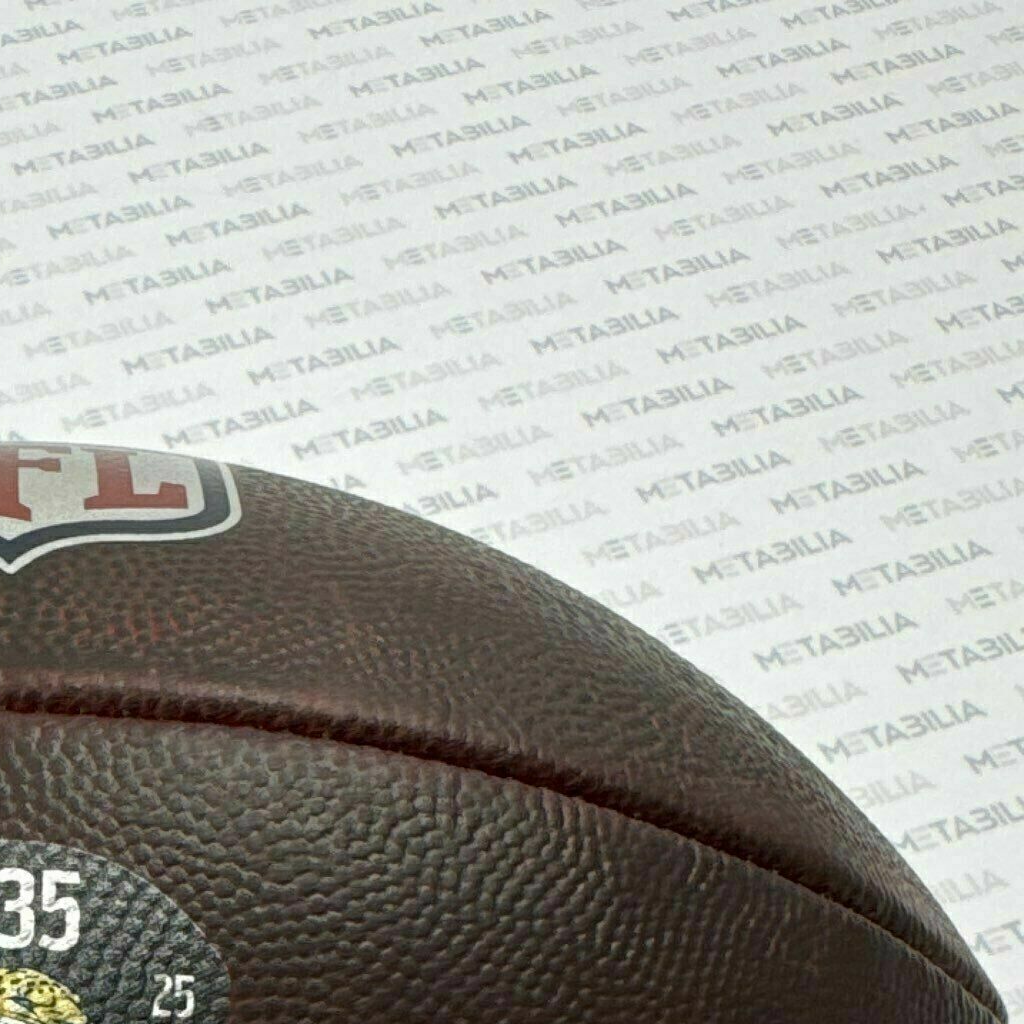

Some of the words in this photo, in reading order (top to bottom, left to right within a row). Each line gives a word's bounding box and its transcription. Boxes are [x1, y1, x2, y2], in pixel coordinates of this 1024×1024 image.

[307, 2, 444, 40] METABILIA
[419, 9, 554, 48] METABILIA
[57, 27, 193, 66] METABILIA
[716, 38, 851, 78] METABILIA
[830, 45, 965, 85] METABILIA
[348, 57, 486, 98] METABILIA
[461, 64, 600, 106] METABILIA
[91, 83, 233, 124] METABILIA
[766, 92, 904, 137] METABILIA
[884, 103, 1021, 145] METABILIA
[11, 133, 156, 176] METABILIA
[390, 116, 531, 158] METABILIA
[506, 122, 648, 165] METABILIA
[127, 142, 271, 185] METABILIA
[819, 155, 960, 199] METABILIA
[47, 195, 195, 240] METABILIA
[434, 175, 578, 220] METABILIA
[554, 183, 698, 228] METABILIA
[165, 202, 313, 247] METABILIA
[875, 218, 1020, 265] METABILIA
[83, 259, 234, 306] METABILIA
[481, 239, 628, 285] METABILIA
[603, 248, 751, 295] METABILIA
[204, 268, 355, 315] METABILIA
[120, 326, 276, 376] METABILIA
[529, 307, 680, 355] METABILIA
[656, 315, 807, 365] METABILIA
[246, 337, 403, 387] METABILIA
[161, 397, 317, 449] METABILIA
[580, 377, 735, 428] METABILIA
[711, 386, 865, 437] METABILIA
[290, 408, 449, 461] METABILIA
[635, 450, 792, 504] METABILIA
[768, 459, 928, 515] METABILIA
[691, 529, 853, 585] METABILIA
[831, 539, 994, 597] METABILIA
[663, 593, 805, 646] ETABILIA
[753, 611, 920, 672] METABILIA
[895, 628, 1024, 685] METABIL
[817, 700, 988, 764] METABILIA
[892, 796, 1024, 853] METABIL
[151, 974, 195, 1018] 25
